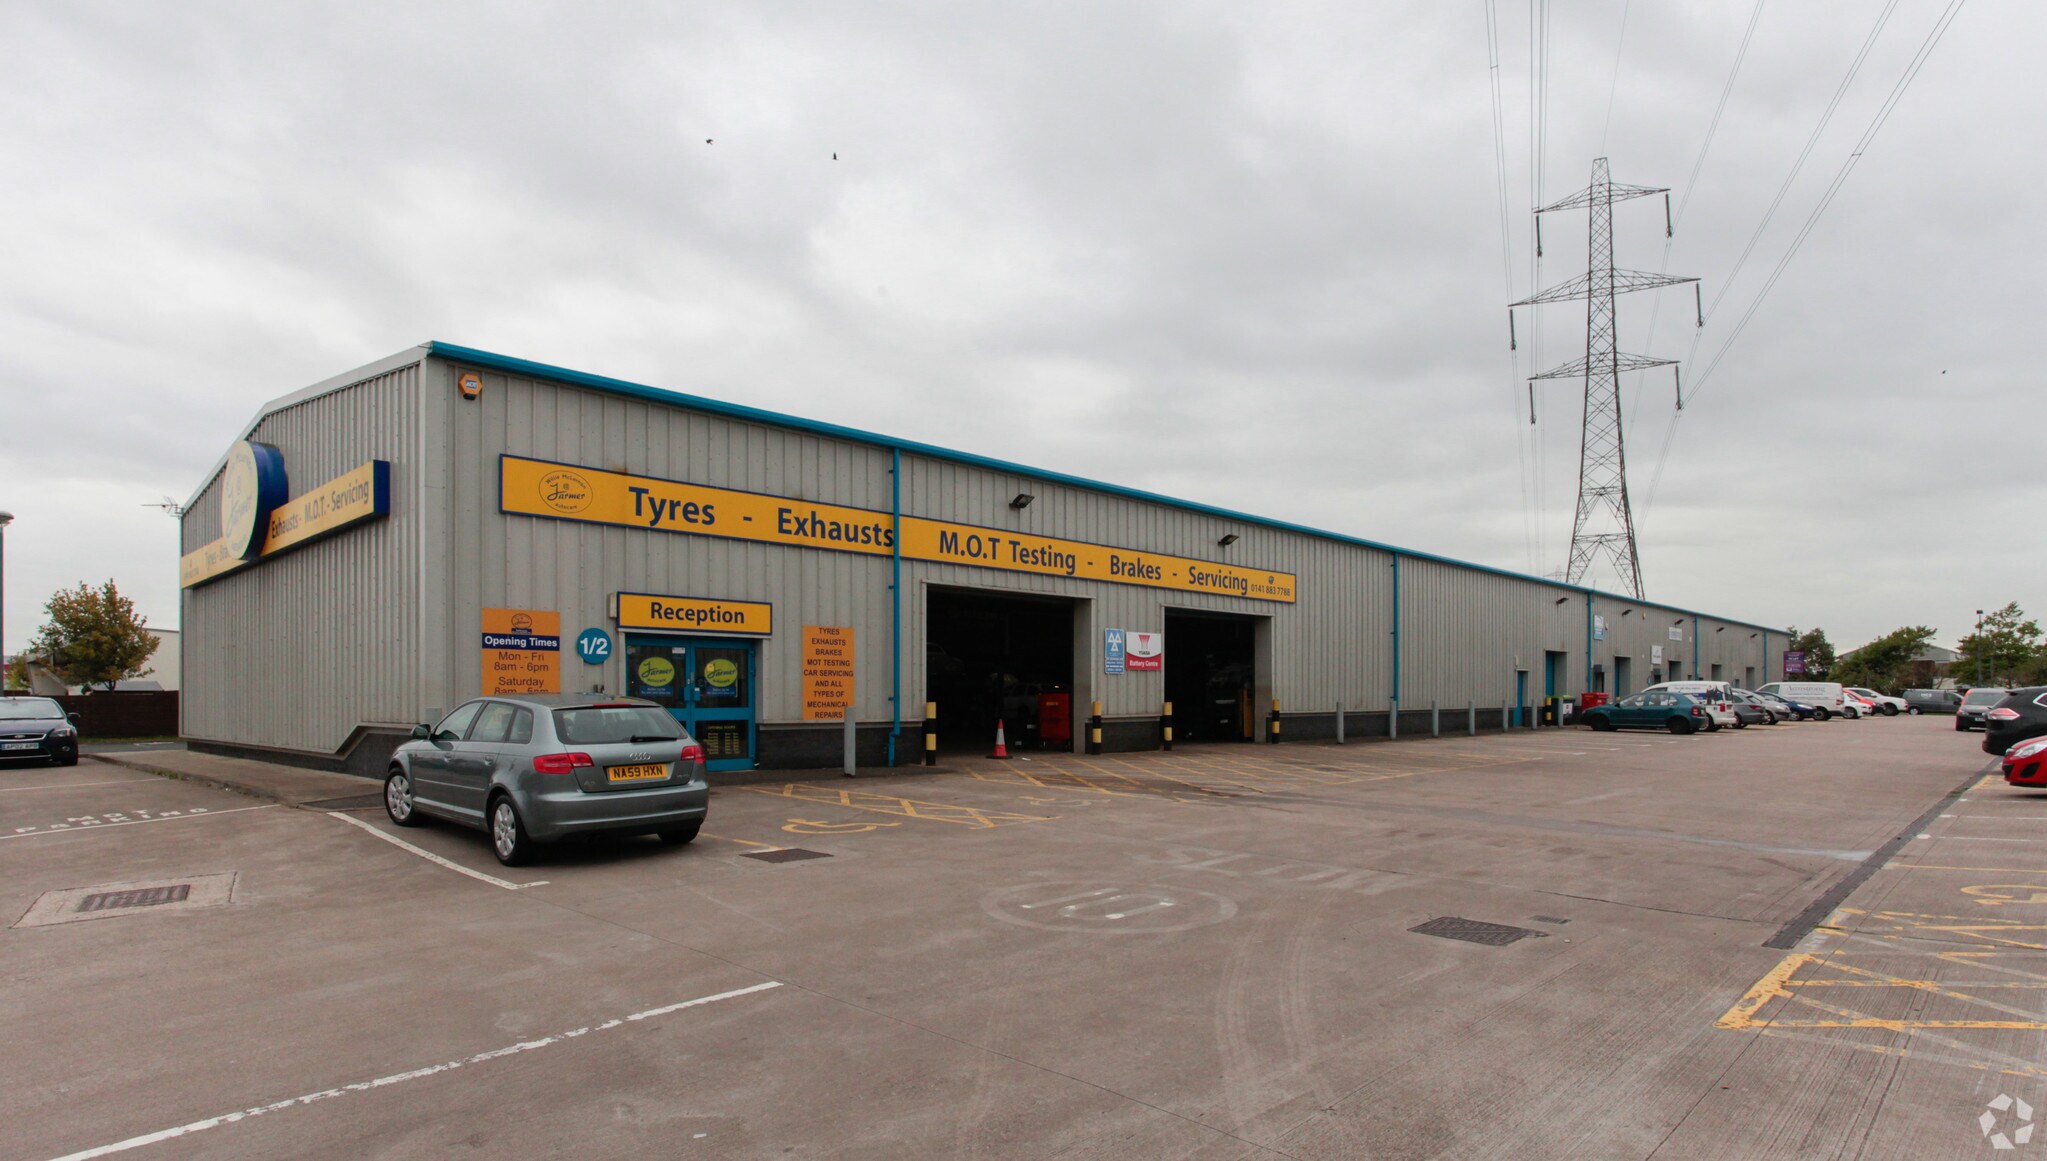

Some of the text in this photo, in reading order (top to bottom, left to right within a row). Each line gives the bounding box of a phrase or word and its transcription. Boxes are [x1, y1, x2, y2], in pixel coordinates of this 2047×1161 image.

[271, 513, 299, 539] Exhausts
[331, 479, 369, 512] Servicing
[628, 486, 716, 527] Tyres
[777, 507, 894, 548] Exhausts
[939, 530, 1000, 560] M.O.T
[1008, 540, 1077, 576] Testing
[1109, 555, 1162, 581] Brakes
[1188, 566, 1249, 595] Servicing
[1250, 583, 1265, 593] 0141
[650, 602, 745, 626] Reception
[819, 627, 840, 635] TYRES
[484, 635, 557, 648] Opening Times
[580, 637, 608, 655] 1/2
[811, 637, 846, 646] EXHAUSTS
[498, 651, 521, 661] Mon
[531, 652, 545, 661] Fri
[815, 648, 843, 656] BRAKES
[494, 662, 517, 671] 8am
[527, 662, 549, 673] 6pm
[823, 659, 850, 667] TESTING
[819, 669, 854, 677] SERVICING
[498, 676, 545, 688] Saturday
[813, 690, 834, 698] TYPES
[814, 711, 843, 719] REPAIRS
[613, 765, 663, 779] NA59 HXN
